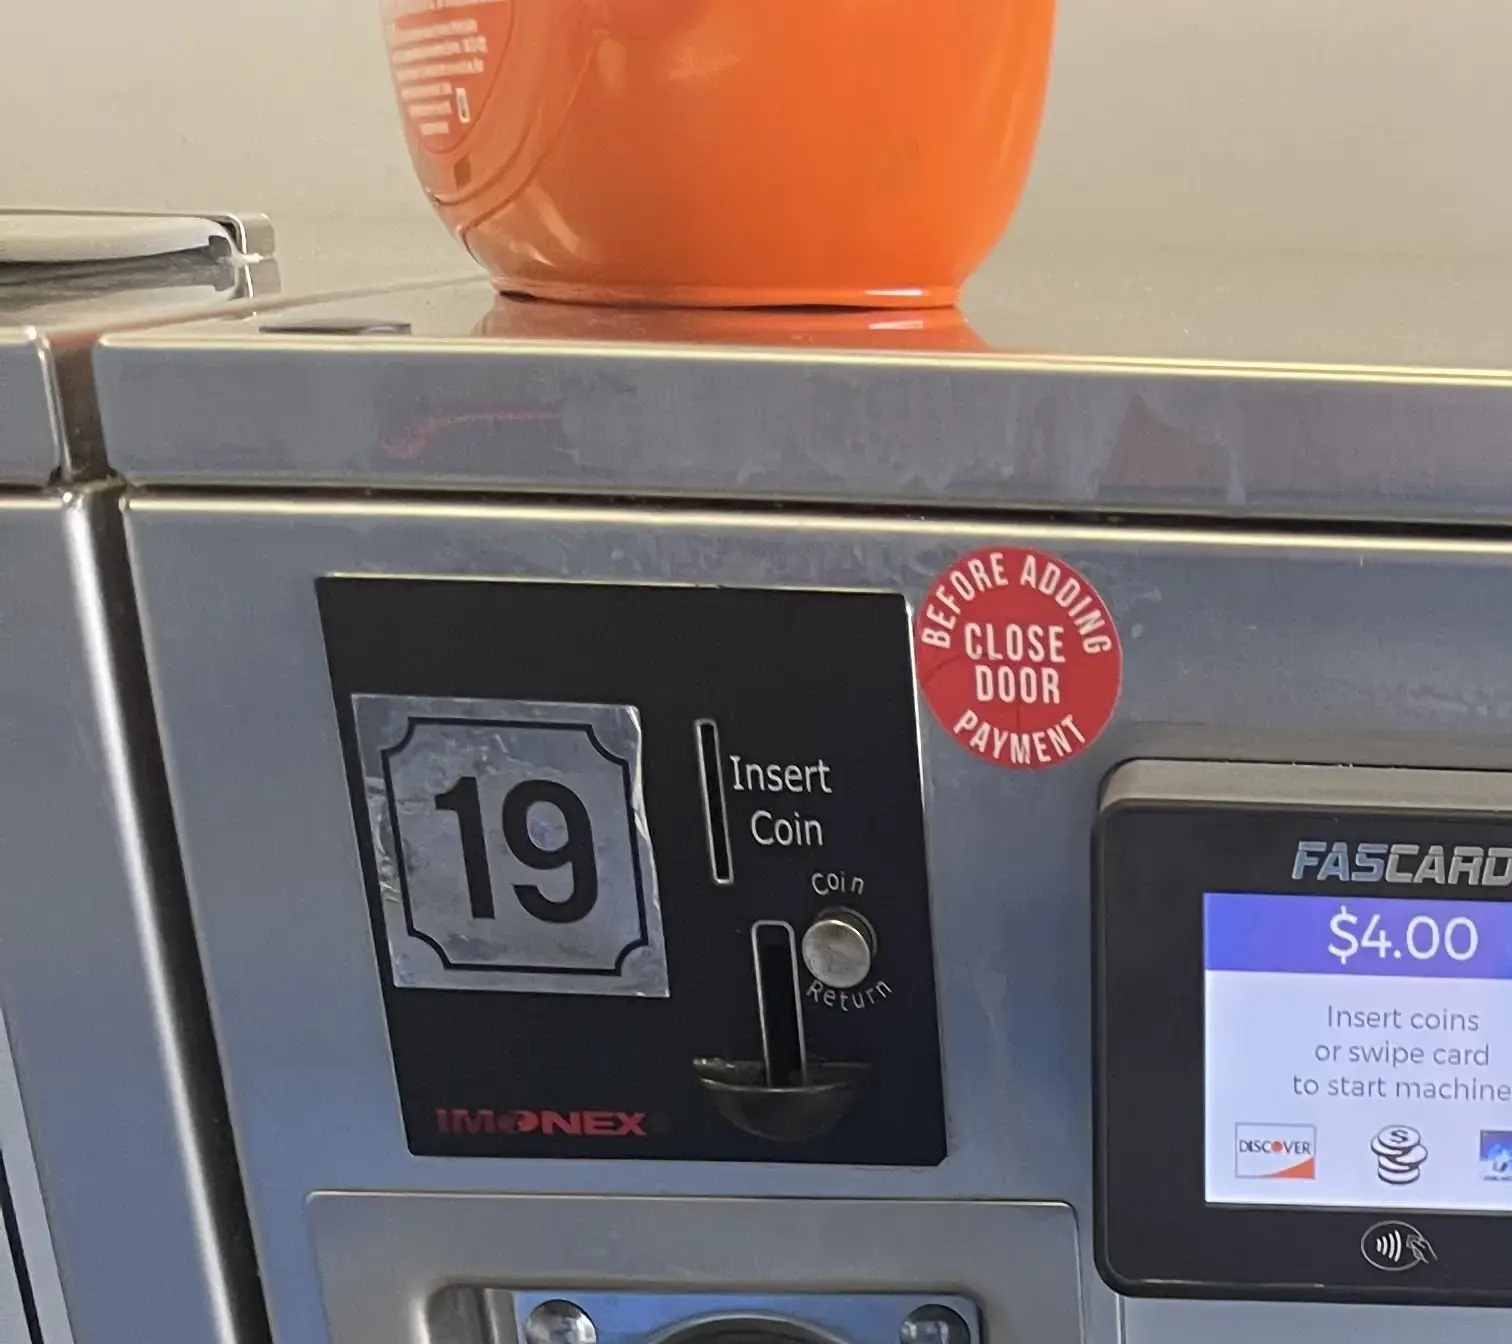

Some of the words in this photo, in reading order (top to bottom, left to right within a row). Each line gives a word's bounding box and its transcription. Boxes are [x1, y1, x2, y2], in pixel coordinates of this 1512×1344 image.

[921, 552, 1007, 649] BEFORE
[1020, 555, 1112, 656] ADDING
[964, 623, 1065, 663] CLOSE
[975, 664, 1061, 704] DOOR
[953, 714, 1085, 764] PAYMENT
[730, 755, 832, 795] Insert
[750, 810, 824, 848] Coin
[433, 775, 600, 926] 19
[811, 870, 865, 895] Coin
[1328, 906, 1478, 964] $4.00
[806, 977, 892, 1012] Return
[1327, 1006, 1401, 1030] Insert
[1410, 1008, 1479, 1031] coins
[1314, 1044, 1341, 1062] or
[1349, 1042, 1425, 1066] swipe
[1432, 1044, 1489, 1067] card
[1292, 1075, 1319, 1095] to
[1327, 1078, 1387, 1098] start
[1395, 1078, 1511, 1101] machine
[436, 1108, 649, 1137] IMONEX
[1238, 1139, 1312, 1156] DISCOVER
